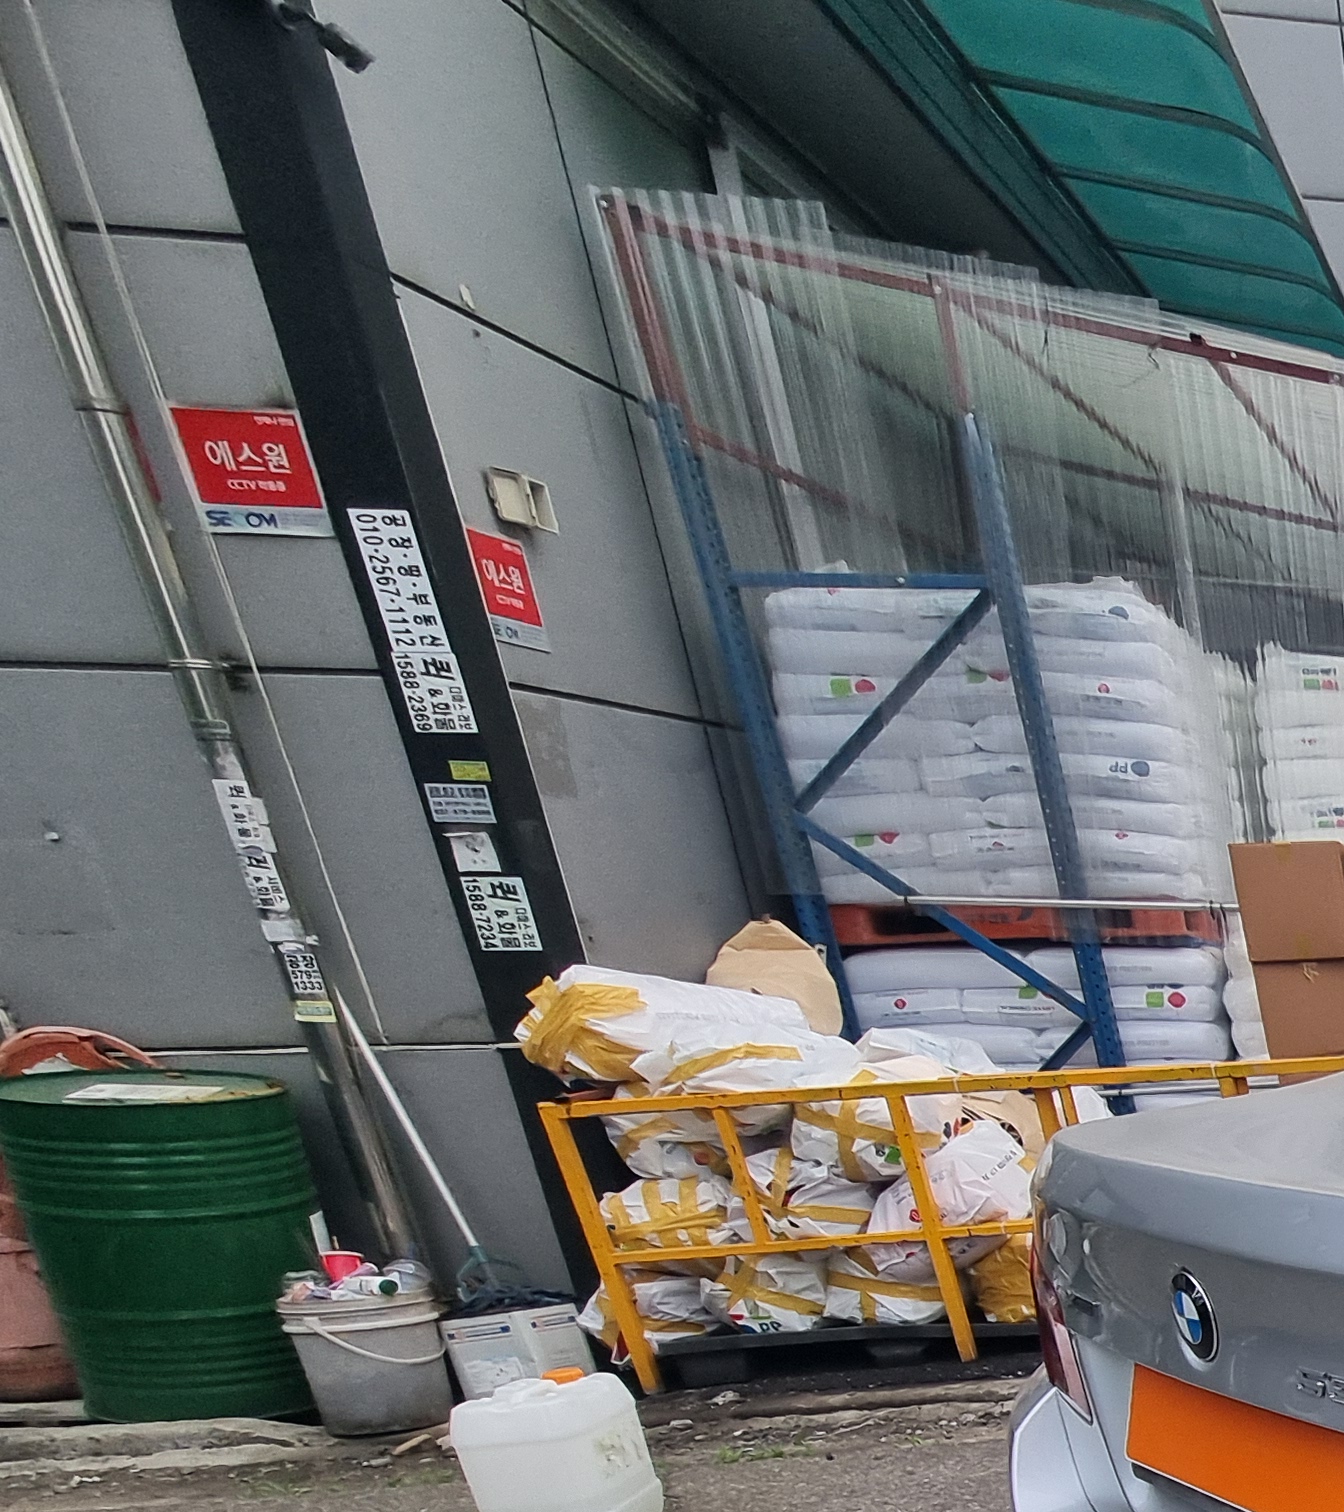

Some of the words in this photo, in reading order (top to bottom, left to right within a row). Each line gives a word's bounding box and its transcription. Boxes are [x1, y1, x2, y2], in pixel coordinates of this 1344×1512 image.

[204, 440, 292, 474] 에스원
[205, 510, 279, 528] SEOM
[481, 558, 525, 594] 에스원
